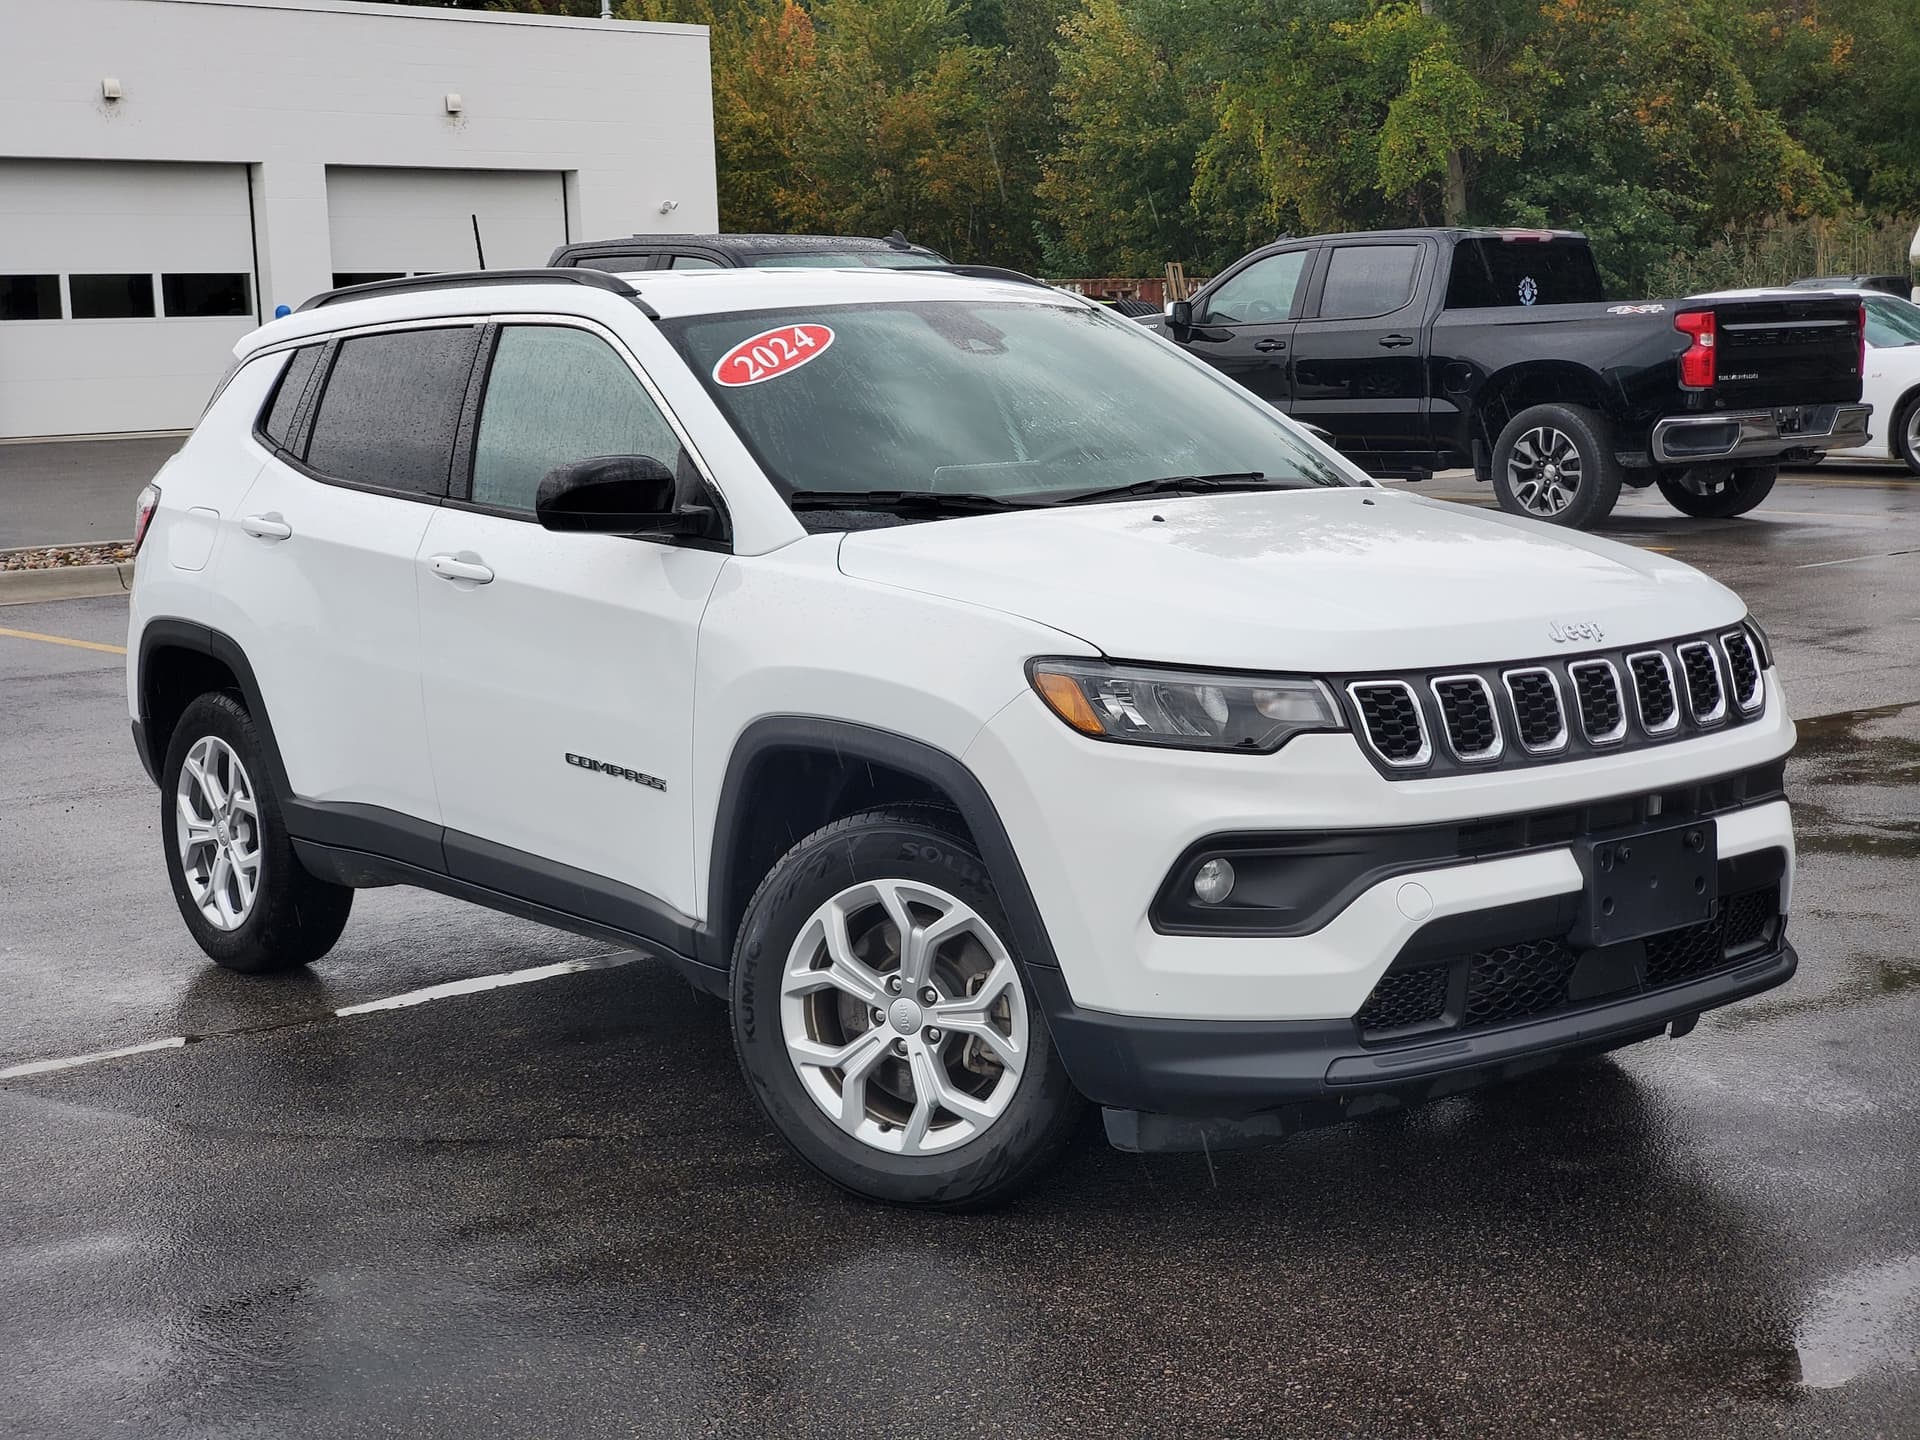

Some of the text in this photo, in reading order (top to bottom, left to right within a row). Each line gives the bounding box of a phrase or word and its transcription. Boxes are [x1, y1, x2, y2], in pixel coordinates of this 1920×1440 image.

[733, 327, 815, 381] 2024
[1548, 621, 1605, 643] Jeep
[565, 752, 667, 793] COMPASS
[743, 940, 762, 1043] KUMHO
